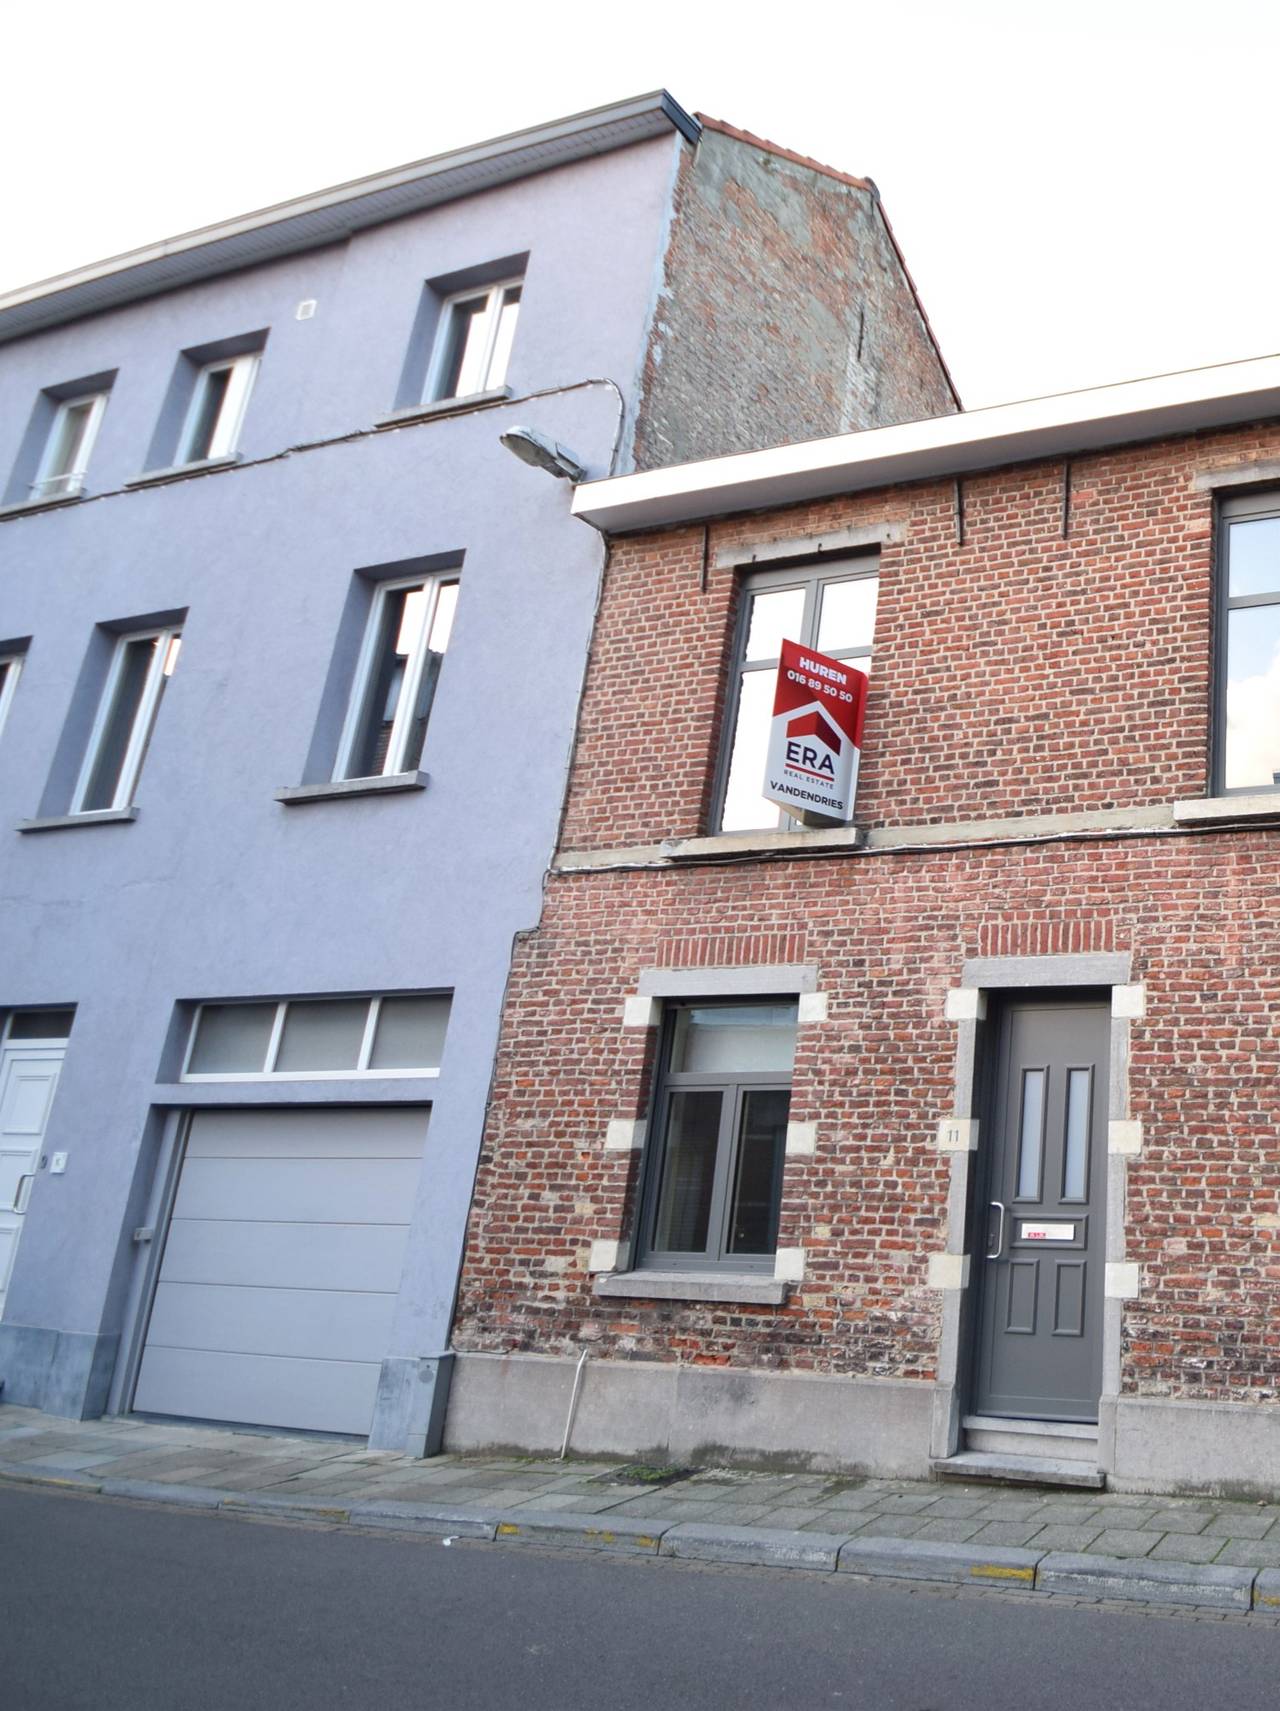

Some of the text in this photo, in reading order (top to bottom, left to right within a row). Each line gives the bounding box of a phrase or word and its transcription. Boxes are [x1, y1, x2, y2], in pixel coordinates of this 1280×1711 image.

[799, 657, 847, 684] HUREN
[787, 670, 853, 703] 016 89 50 50
[786, 741, 834, 774] ERA
[784, 770, 834, 790] REAL ESTATE
[770, 780, 843, 810] VANDENDRIES
[947, 1129, 959, 1142] 11
